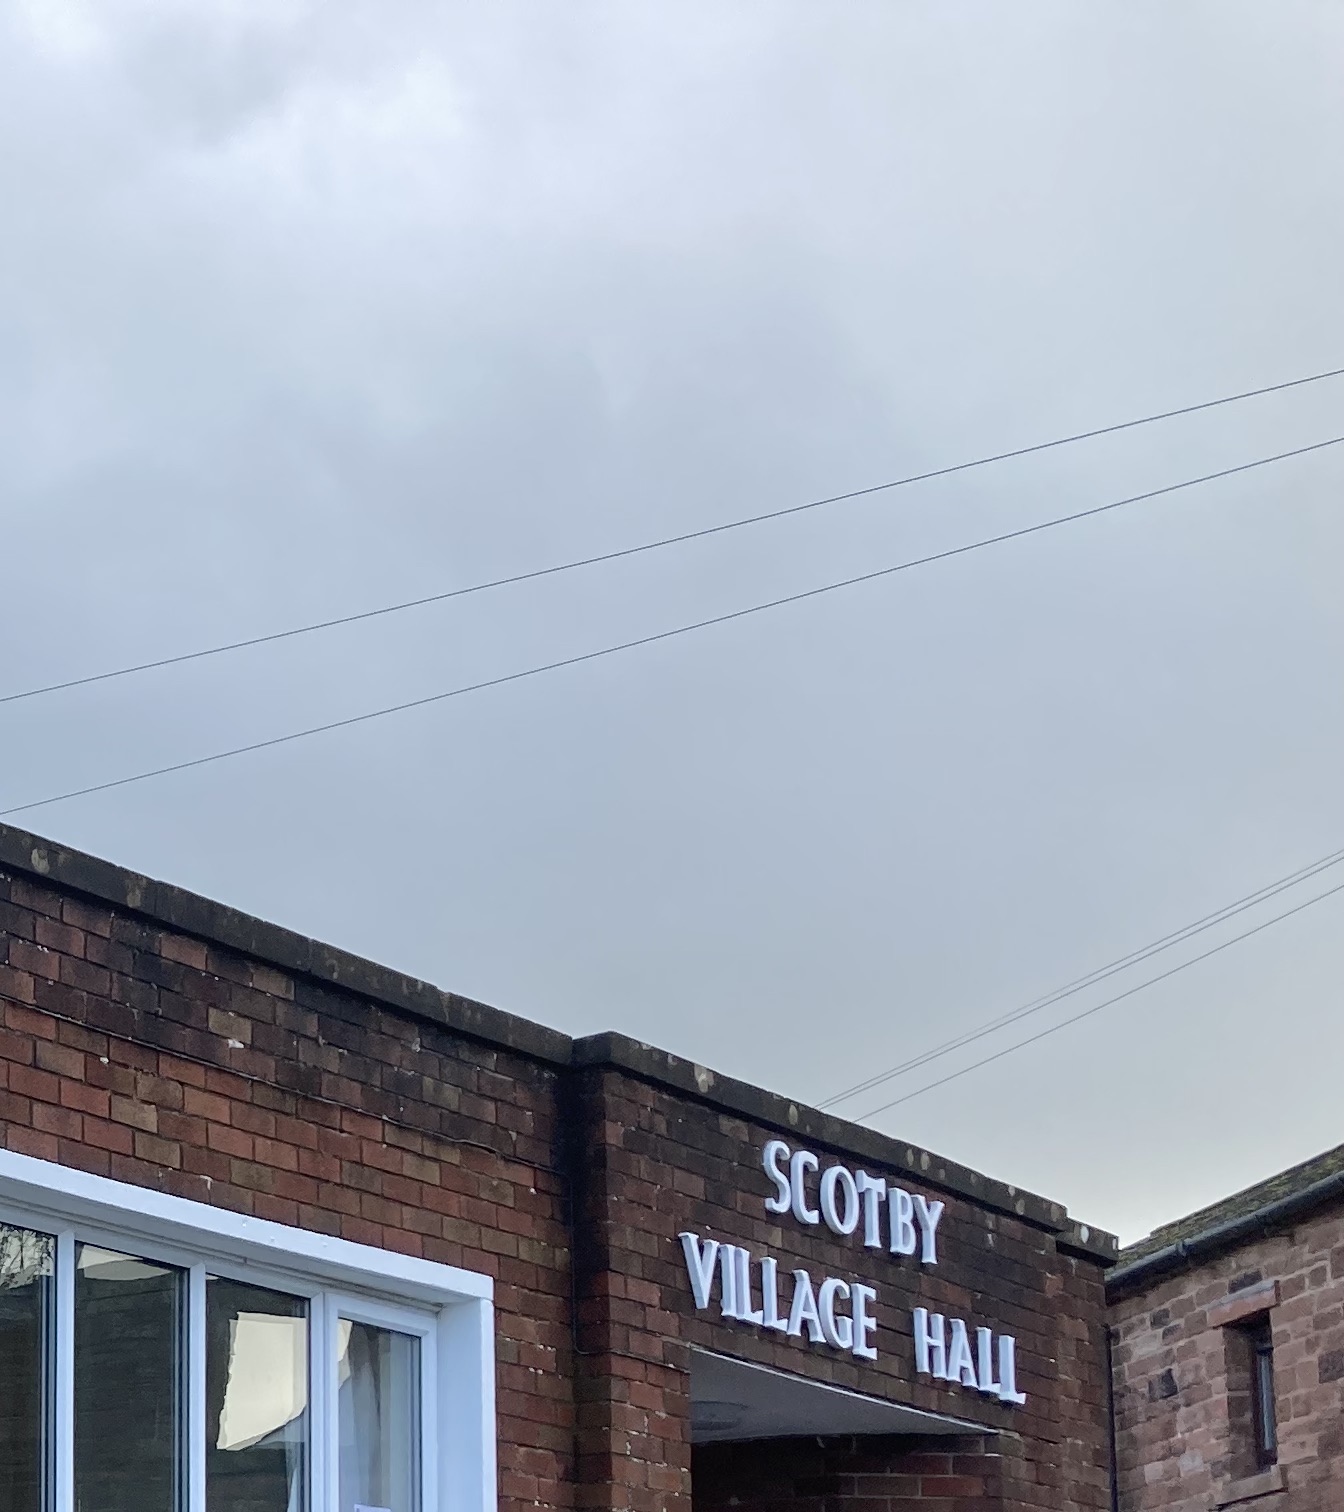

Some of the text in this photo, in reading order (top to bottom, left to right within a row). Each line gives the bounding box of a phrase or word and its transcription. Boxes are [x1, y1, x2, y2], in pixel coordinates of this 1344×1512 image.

[763, 1140, 945, 1265] SCOTBY
[677, 1232, 1026, 1405] VILLAGE HALL
